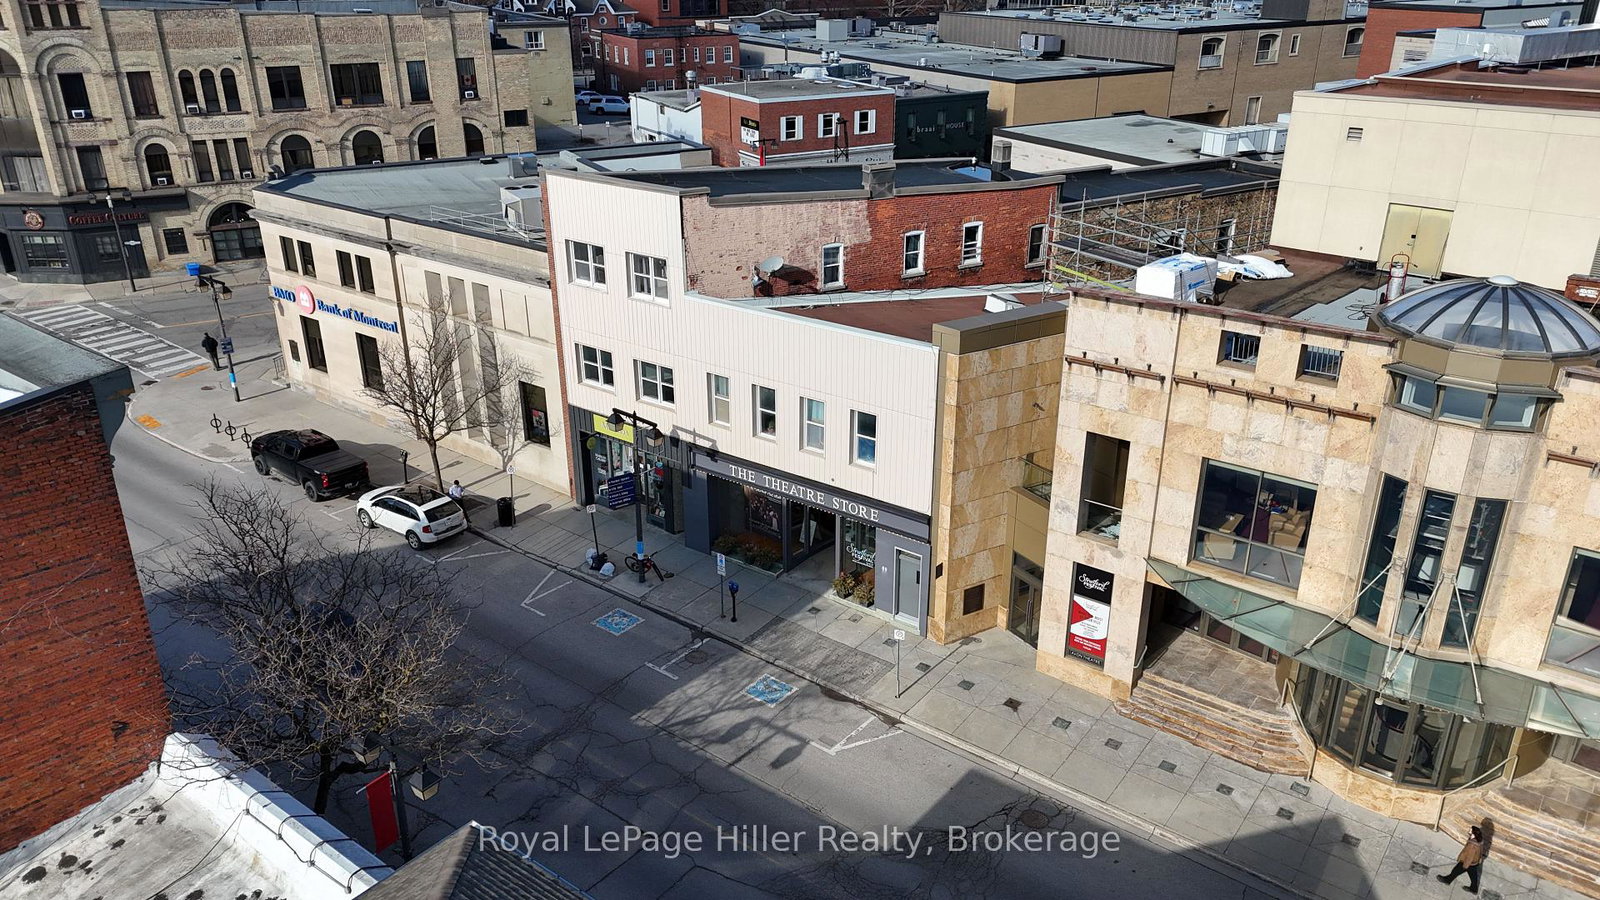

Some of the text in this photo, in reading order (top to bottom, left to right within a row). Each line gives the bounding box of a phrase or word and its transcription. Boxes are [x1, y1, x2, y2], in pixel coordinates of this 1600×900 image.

[69, 215, 104, 226] COFFEE
[272, 286, 399, 334] BMO Bank of Montreal
[729, 465, 756, 483] THE
[763, 475, 825, 505] THEATRE
[832, 497, 879, 522] STORE
